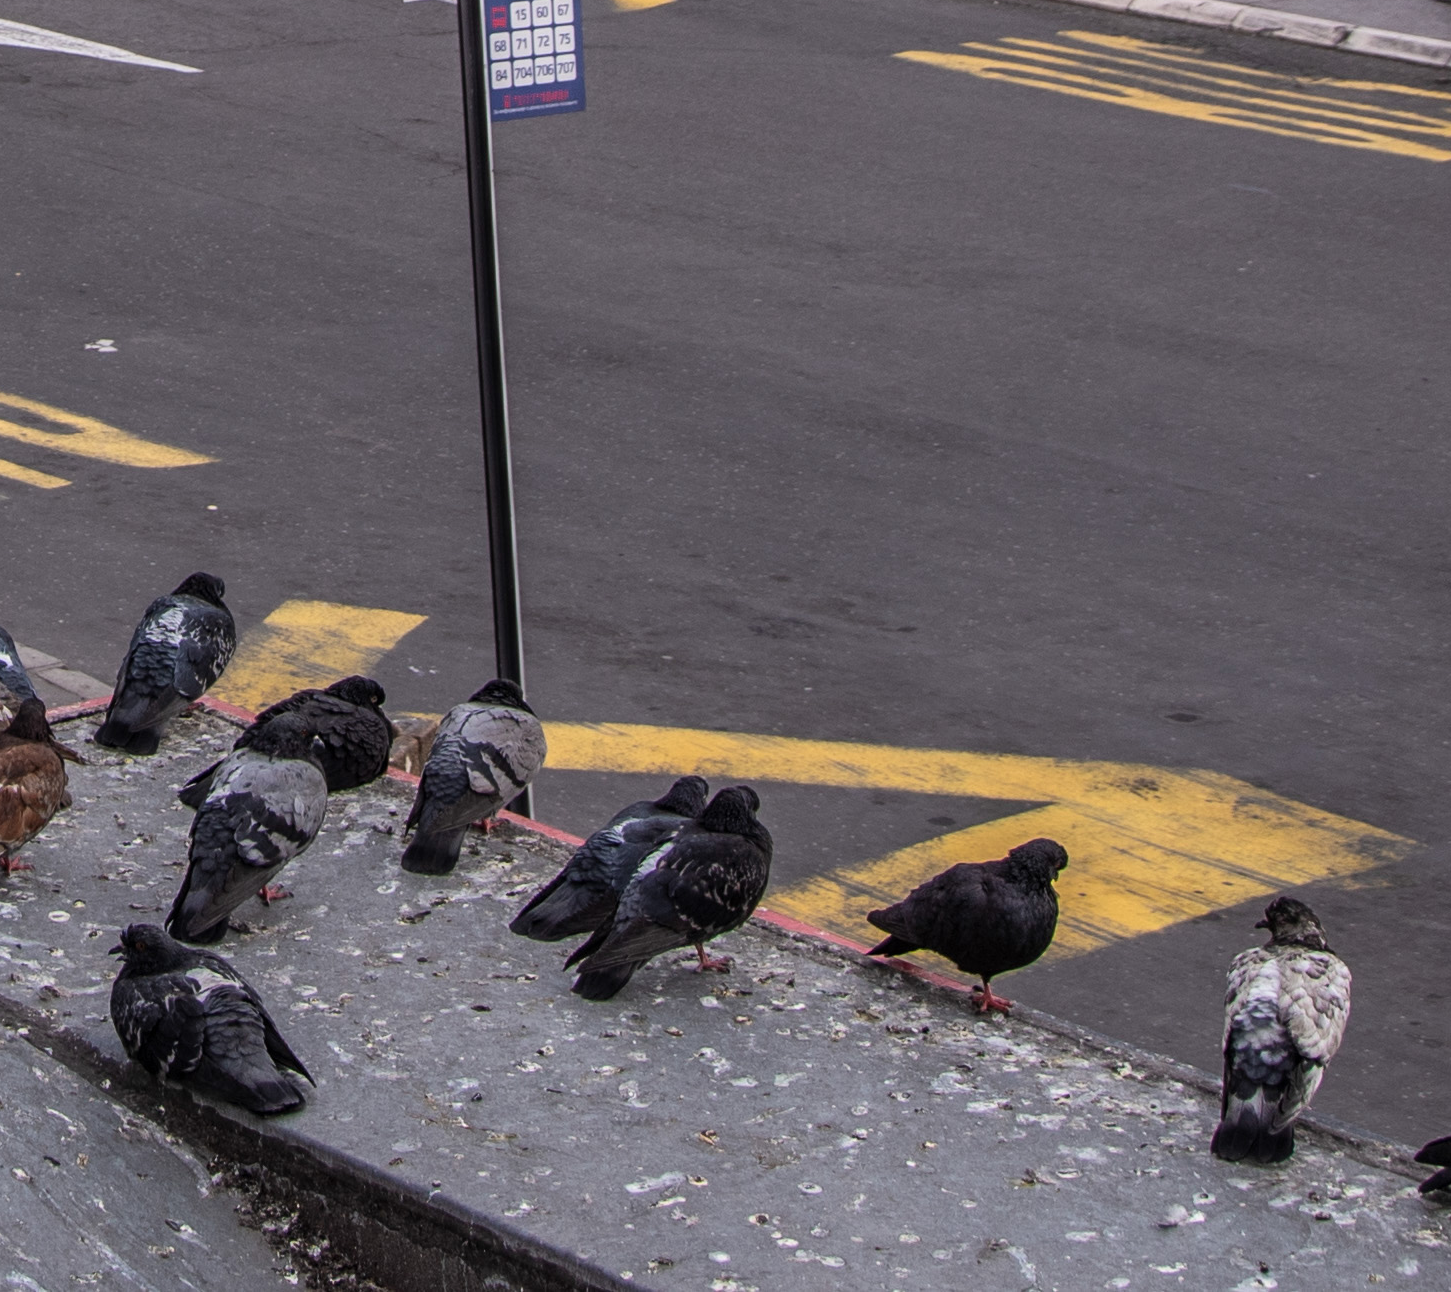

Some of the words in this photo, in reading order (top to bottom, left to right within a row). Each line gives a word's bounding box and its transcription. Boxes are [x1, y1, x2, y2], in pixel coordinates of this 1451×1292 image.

[515, 8, 527, 21] 15
[536, 6, 548, 18] 60
[557, 3, 569, 16] 67
[494, 40, 507, 53] 68
[515, 38, 528, 50] 71
[538, 35, 550, 48] 72
[559, 33, 571, 45] 75
[495, 69, 508, 82] 84
[515, 66, 533, 79] 704
[536, 63, 554, 77] 706
[557, 61, 575, 74] 707
